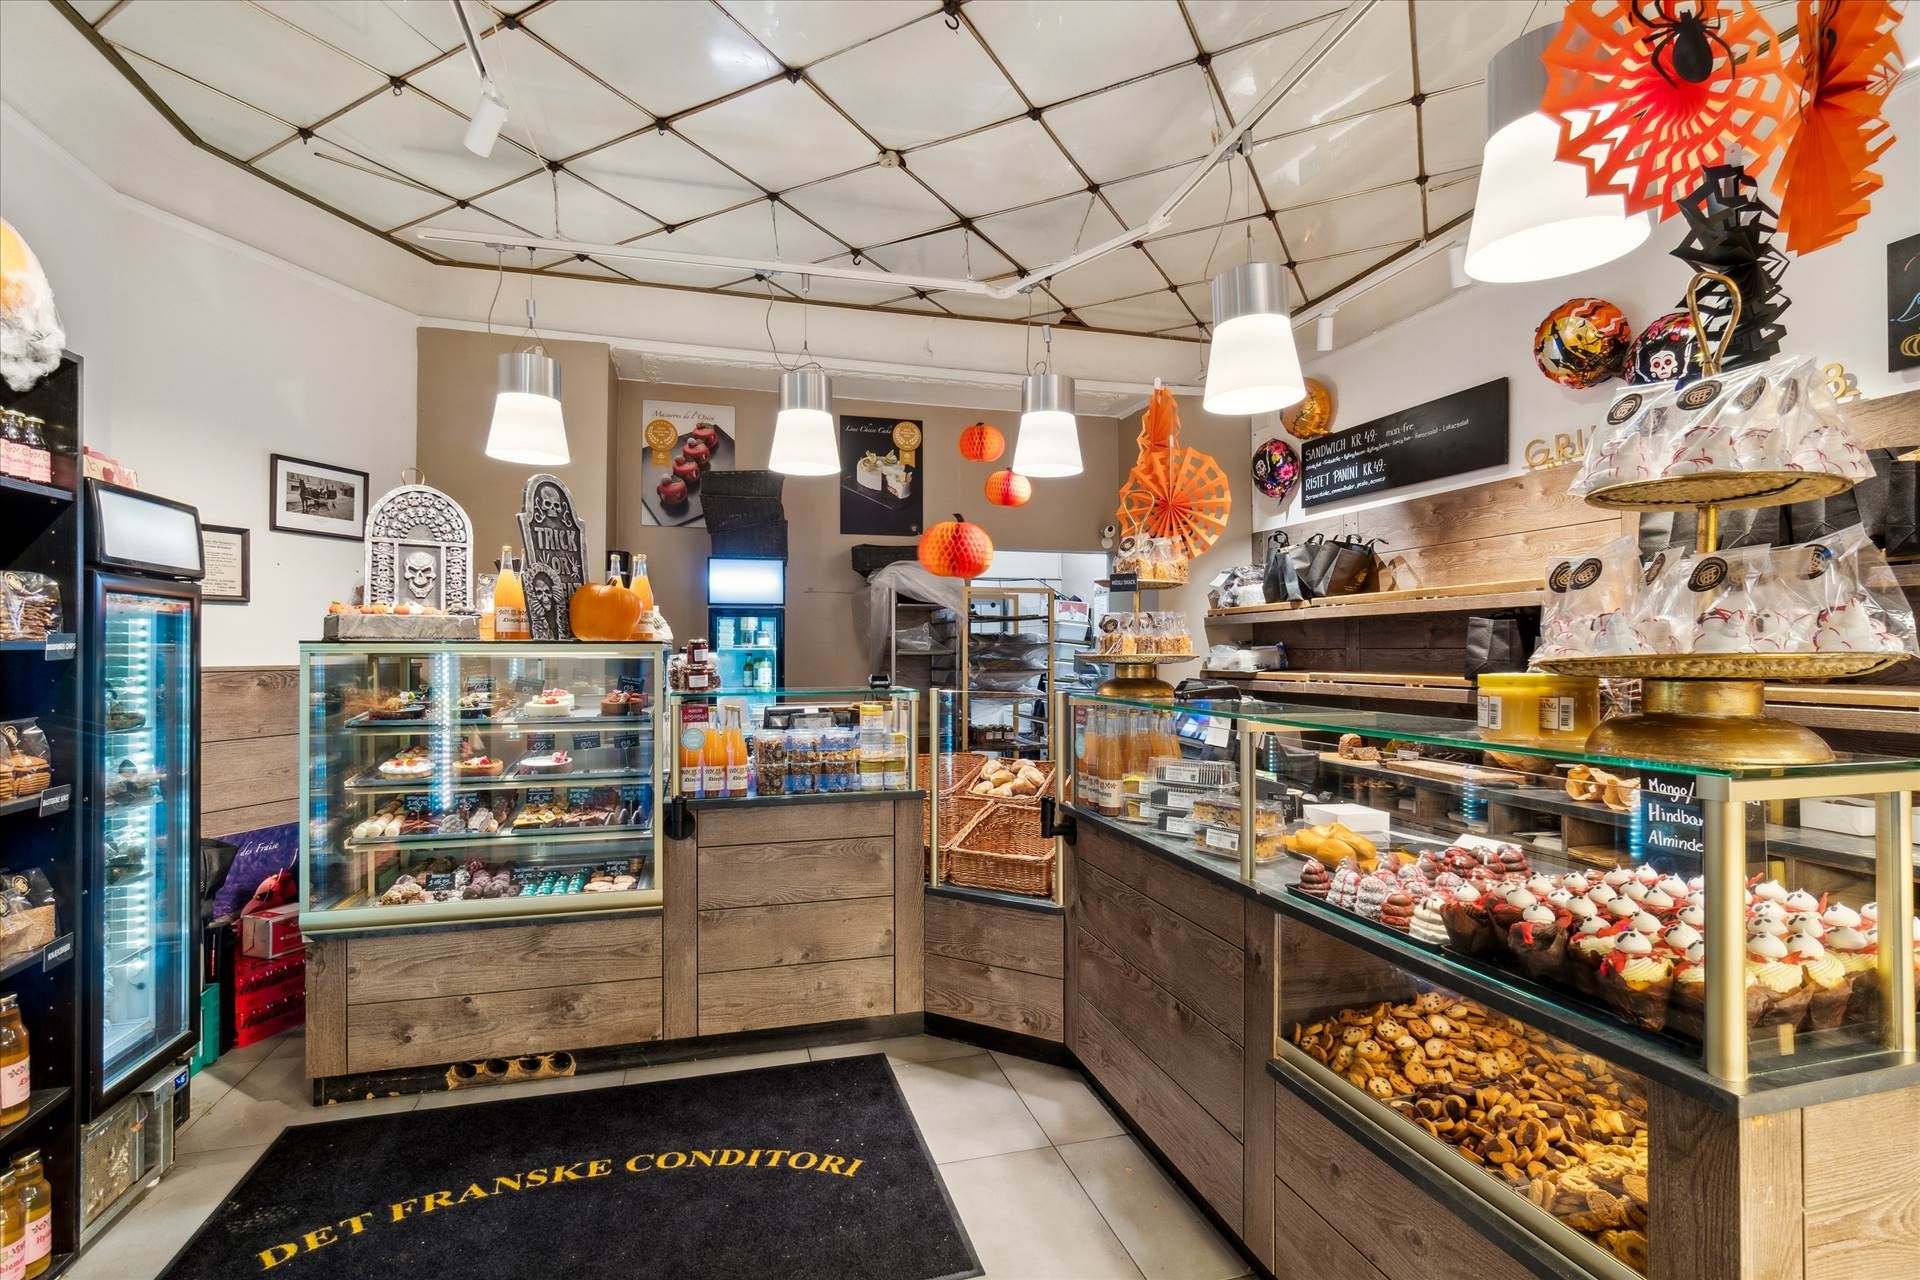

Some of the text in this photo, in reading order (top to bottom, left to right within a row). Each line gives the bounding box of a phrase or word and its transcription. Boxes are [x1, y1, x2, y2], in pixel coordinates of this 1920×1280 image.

[1305, 438, 1346, 462] SANDWICH
[1351, 433, 1362, 448] KR
[1362, 462, 1374, 476] KR
[534, 527, 578, 552] TRICK
[551, 556, 571, 576] OR
[1648, 777, 1695, 804] Mango/
[254, 1148, 866, 1271] DET FRANSKE CONDITORI
